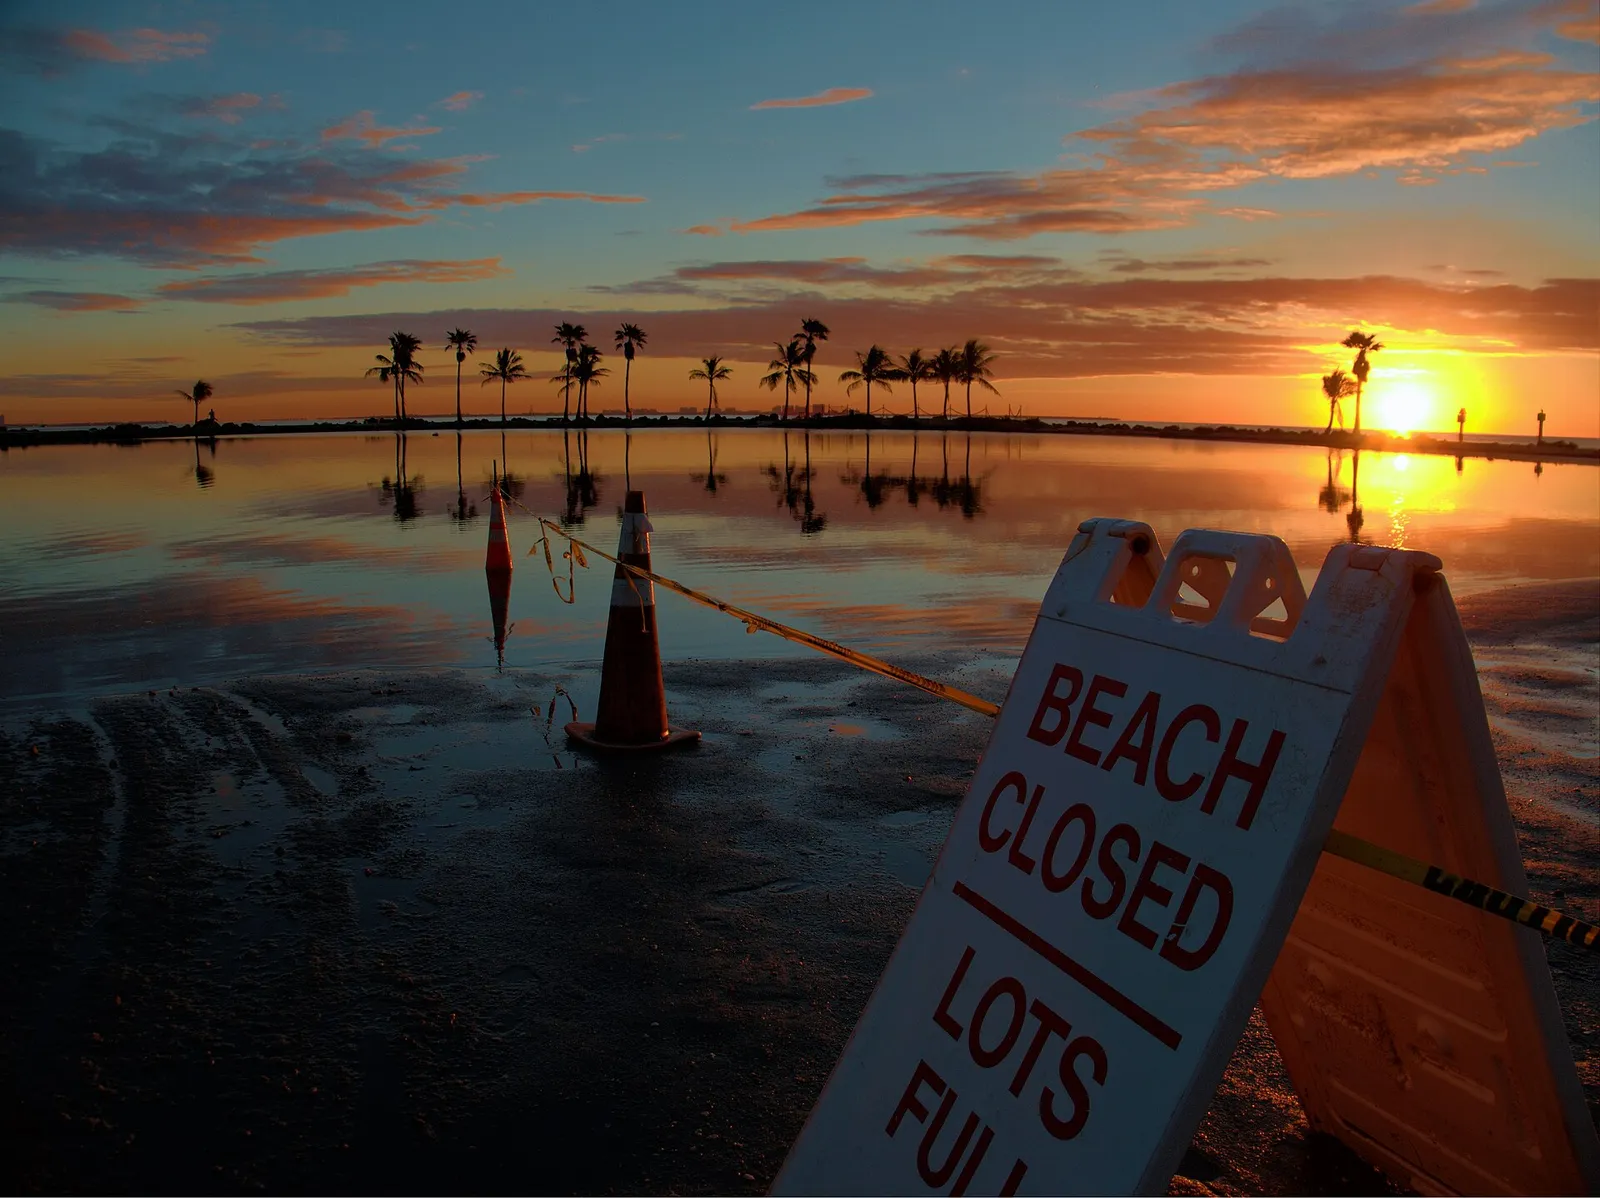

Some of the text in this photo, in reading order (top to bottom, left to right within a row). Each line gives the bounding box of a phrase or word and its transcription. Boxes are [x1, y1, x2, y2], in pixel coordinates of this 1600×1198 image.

[1027, 662, 1287, 831] BEACH
[979, 771, 1234, 971] CLOSED
[932, 946, 1108, 1140] LOTS
